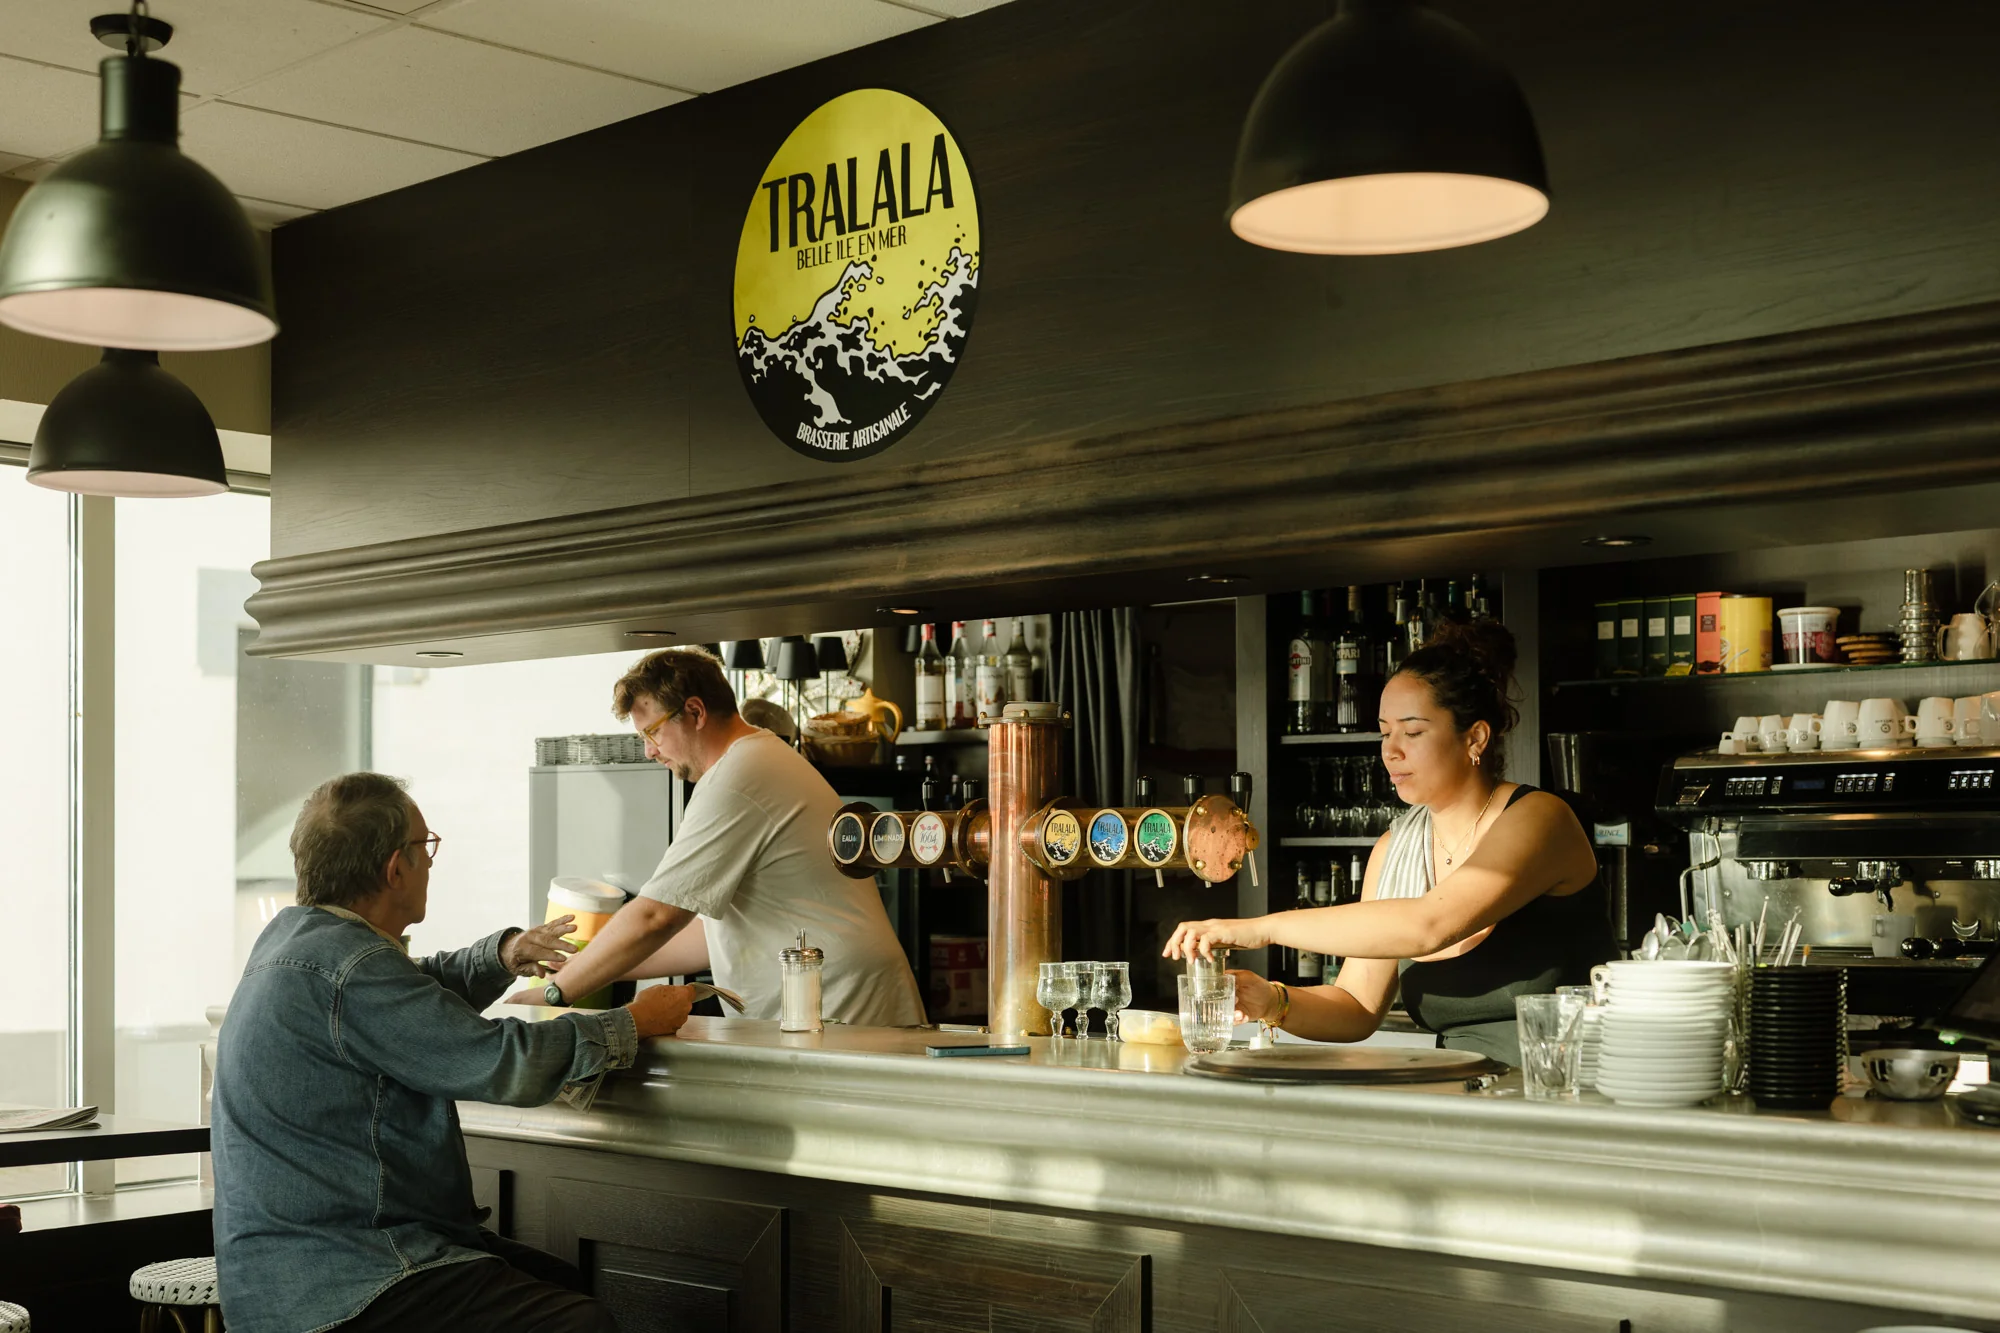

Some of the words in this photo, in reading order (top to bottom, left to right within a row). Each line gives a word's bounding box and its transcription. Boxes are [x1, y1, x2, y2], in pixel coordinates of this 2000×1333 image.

[762, 133, 954, 253] TRALALA
[797, 242, 833, 270] BELLE
[836, 237, 854, 260] ILE
[859, 231, 876, 255] EN
[879, 225, 907, 250] MER
[796, 421, 850, 451] BRASSERIE
[852, 402, 912, 450] ARTISANALE
[1051, 822, 1076, 834] TRALALA
[1097, 821, 1123, 834] TRALALA
[1144, 822, 1171, 834] TRALALA
[841, 834, 853, 843] EAU
[874, 834, 904, 842] LIMONADE
